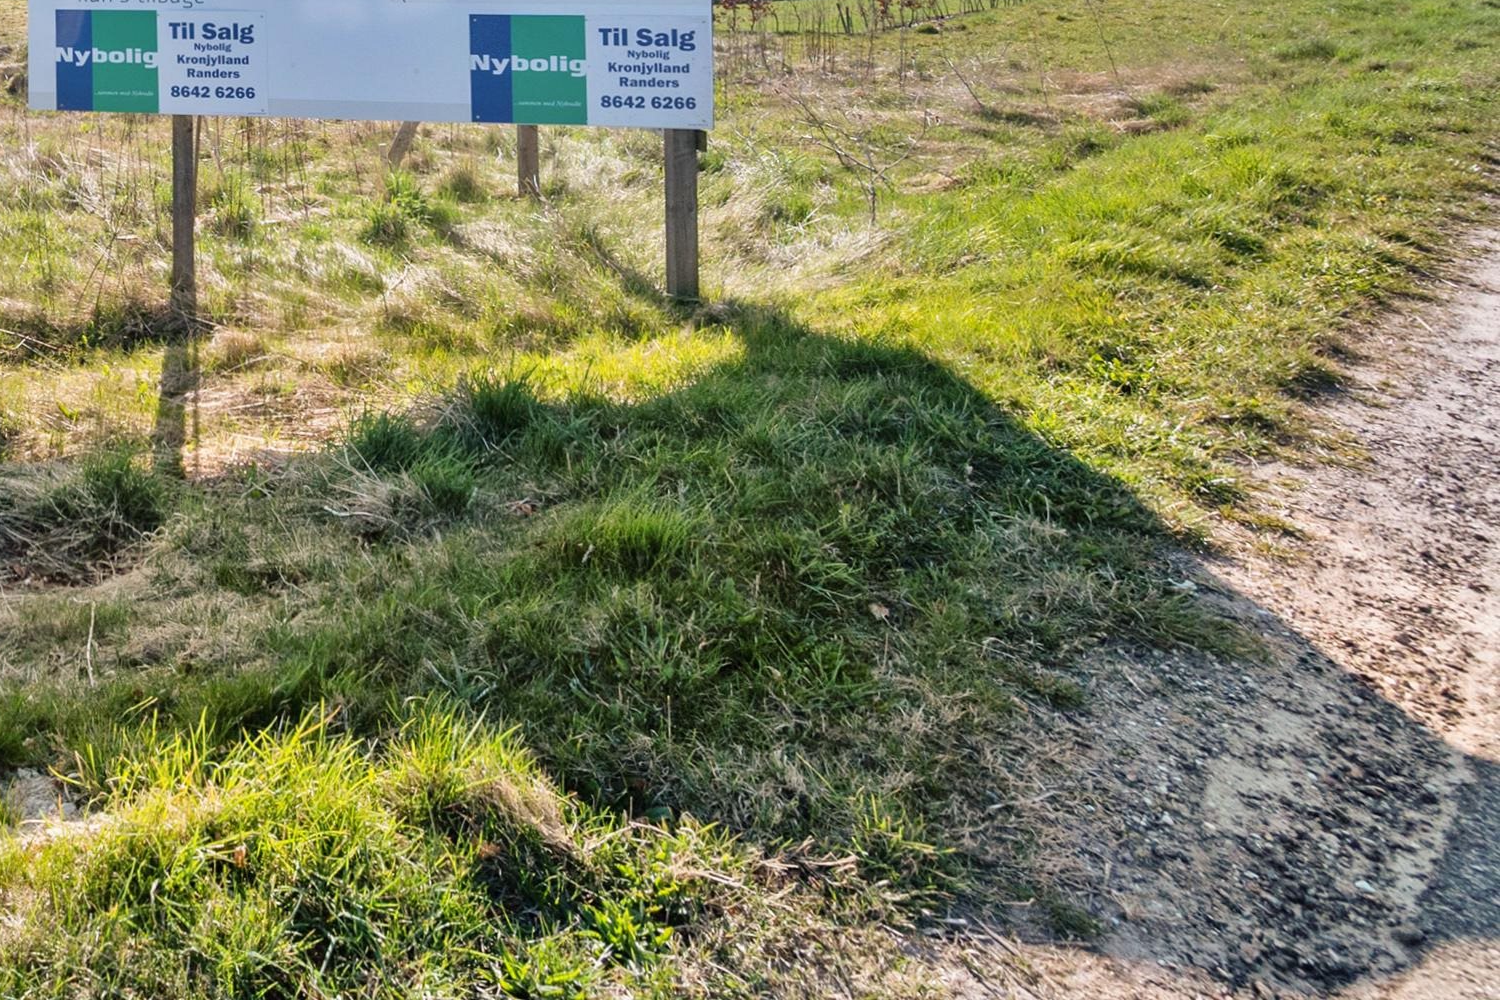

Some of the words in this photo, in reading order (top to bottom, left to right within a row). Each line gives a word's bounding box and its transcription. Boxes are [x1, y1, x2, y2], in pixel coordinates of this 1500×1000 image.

[168, 22, 195, 40] Til
[202, 22, 255, 44] Salg
[598, 28, 628, 46] Til
[636, 28, 696, 51] Salg
[193, 42, 232, 53] Nybolig
[56, 47, 159, 69] Nybolig
[176, 54, 250, 67] Kronjylland
[627, 50, 670, 60] Nybolig
[469, 54, 587, 78] Nybolig
[608, 62, 690, 75] Kronjylland
[186, 68, 241, 79] Randers
[619, 77, 680, 88] Randers
[170, 86, 211, 99] 8642
[215, 86, 256, 99] 6266
[600, 95, 646, 109] 8642
[651, 96, 697, 110] 6266
